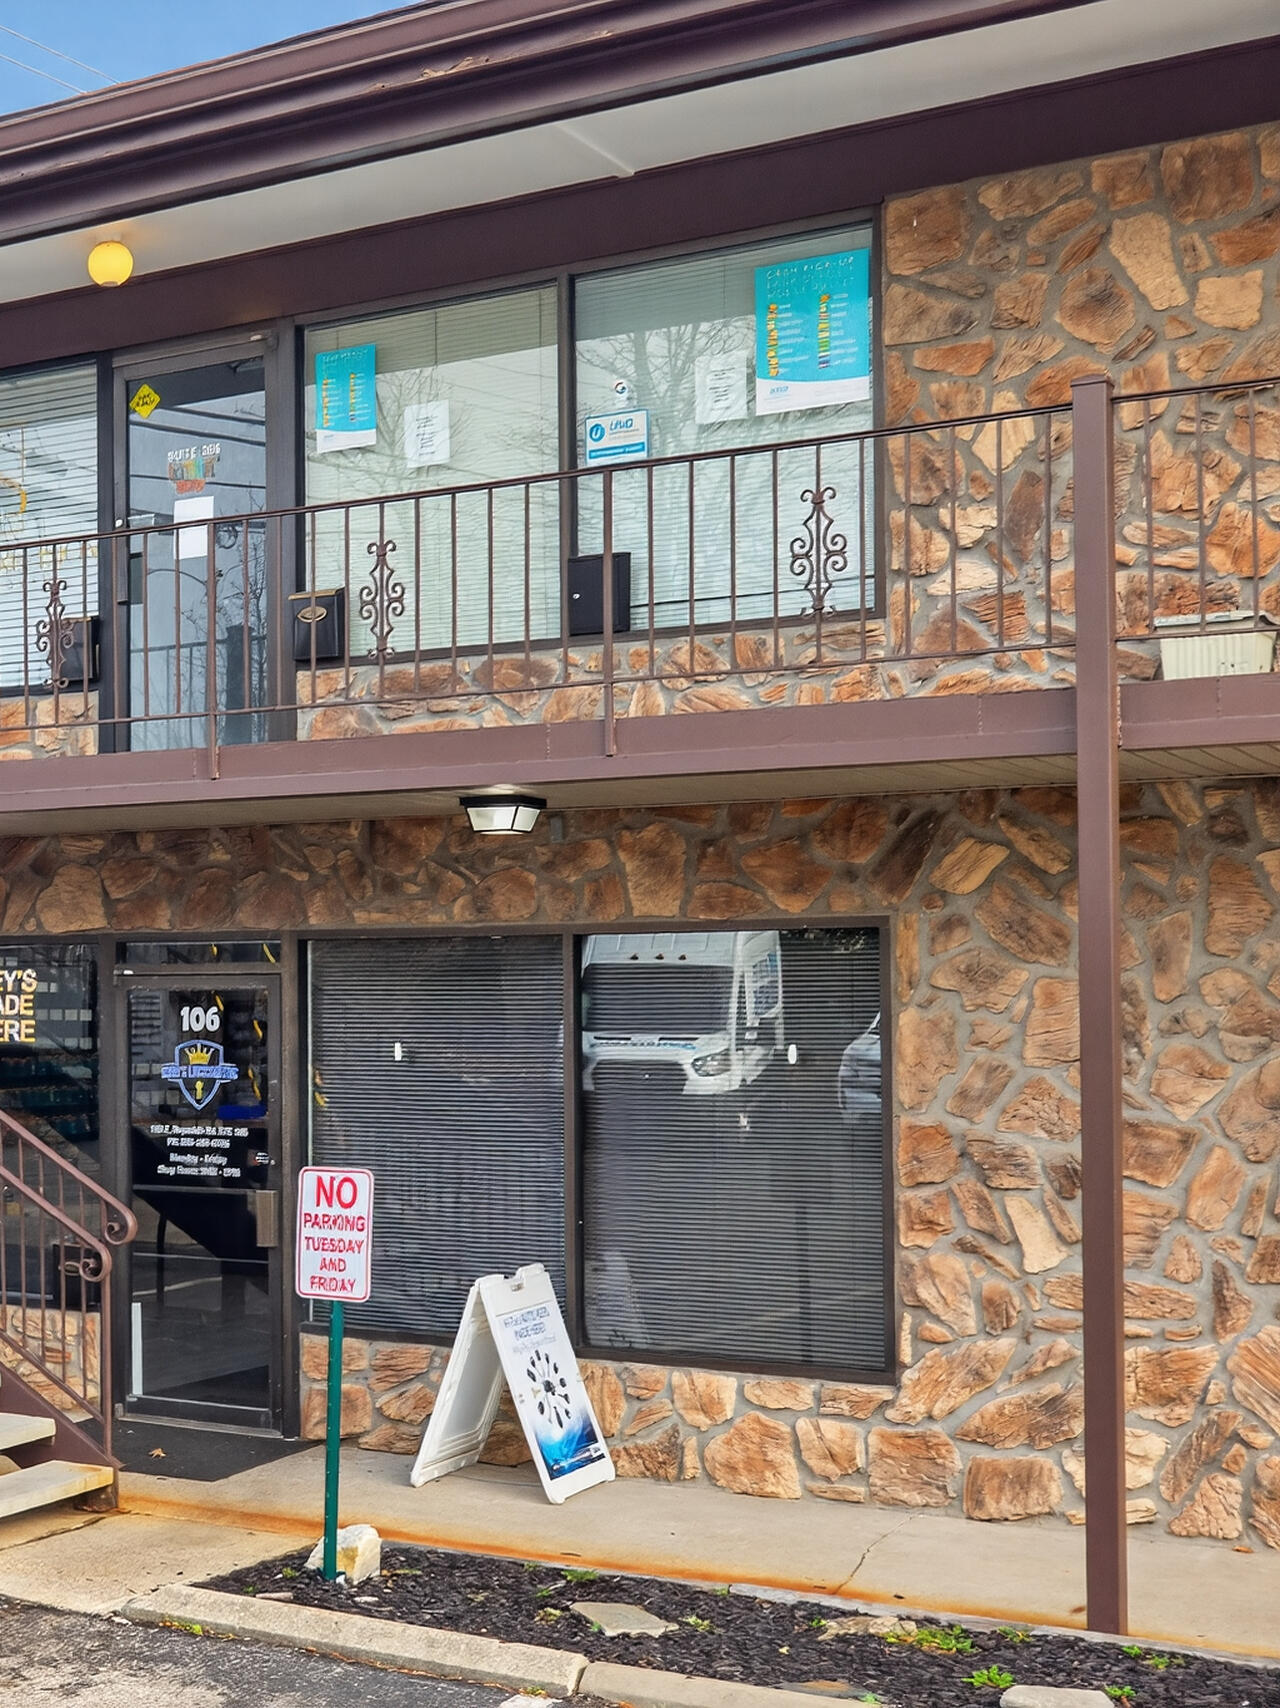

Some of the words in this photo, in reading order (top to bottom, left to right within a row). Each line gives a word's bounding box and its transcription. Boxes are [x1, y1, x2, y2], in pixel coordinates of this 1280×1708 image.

[180, 1005, 220, 1032] 106
[315, 1175, 358, 1209] NO
[303, 1212, 366, 1232] PARKING
[304, 1236, 365, 1254] TUESDAY
[320, 1257, 347, 1272] AND
[310, 1275, 356, 1293] FRIDAY
